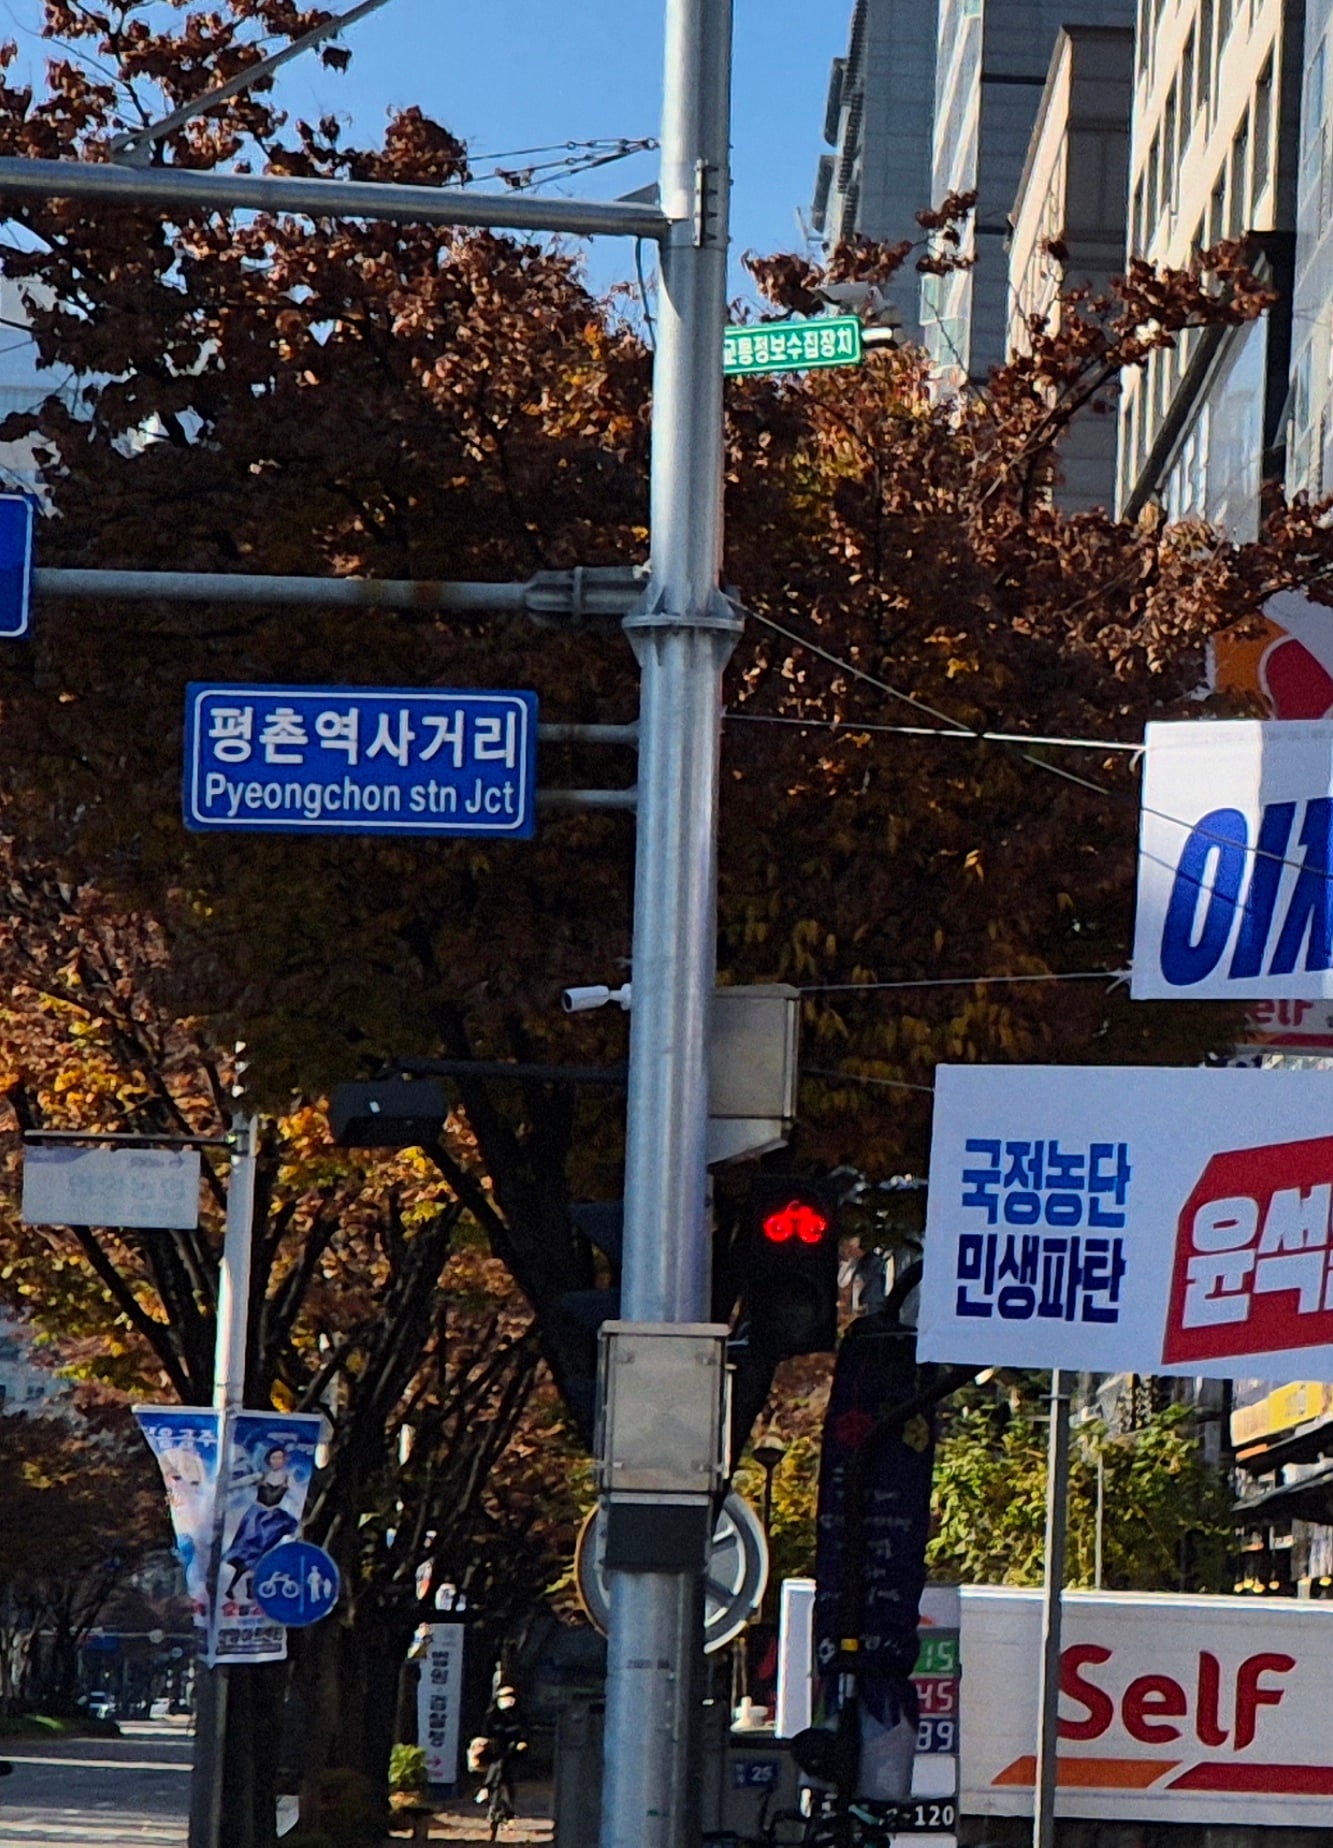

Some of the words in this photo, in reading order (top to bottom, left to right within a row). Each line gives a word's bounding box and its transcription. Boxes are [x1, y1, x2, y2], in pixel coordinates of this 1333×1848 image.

[208, 706, 517, 769] 평촌역사거리
[206, 773, 400, 818] Pyeongchon
[409, 778, 457, 813] stn
[465, 779, 514, 816] Jct
[1248, 1000, 1314, 1026] elf
[962, 1138, 1132, 1228] 국정농단
[955, 1233, 1125, 1326] 민생파탄
[1056, 1644, 1296, 1751] Self
